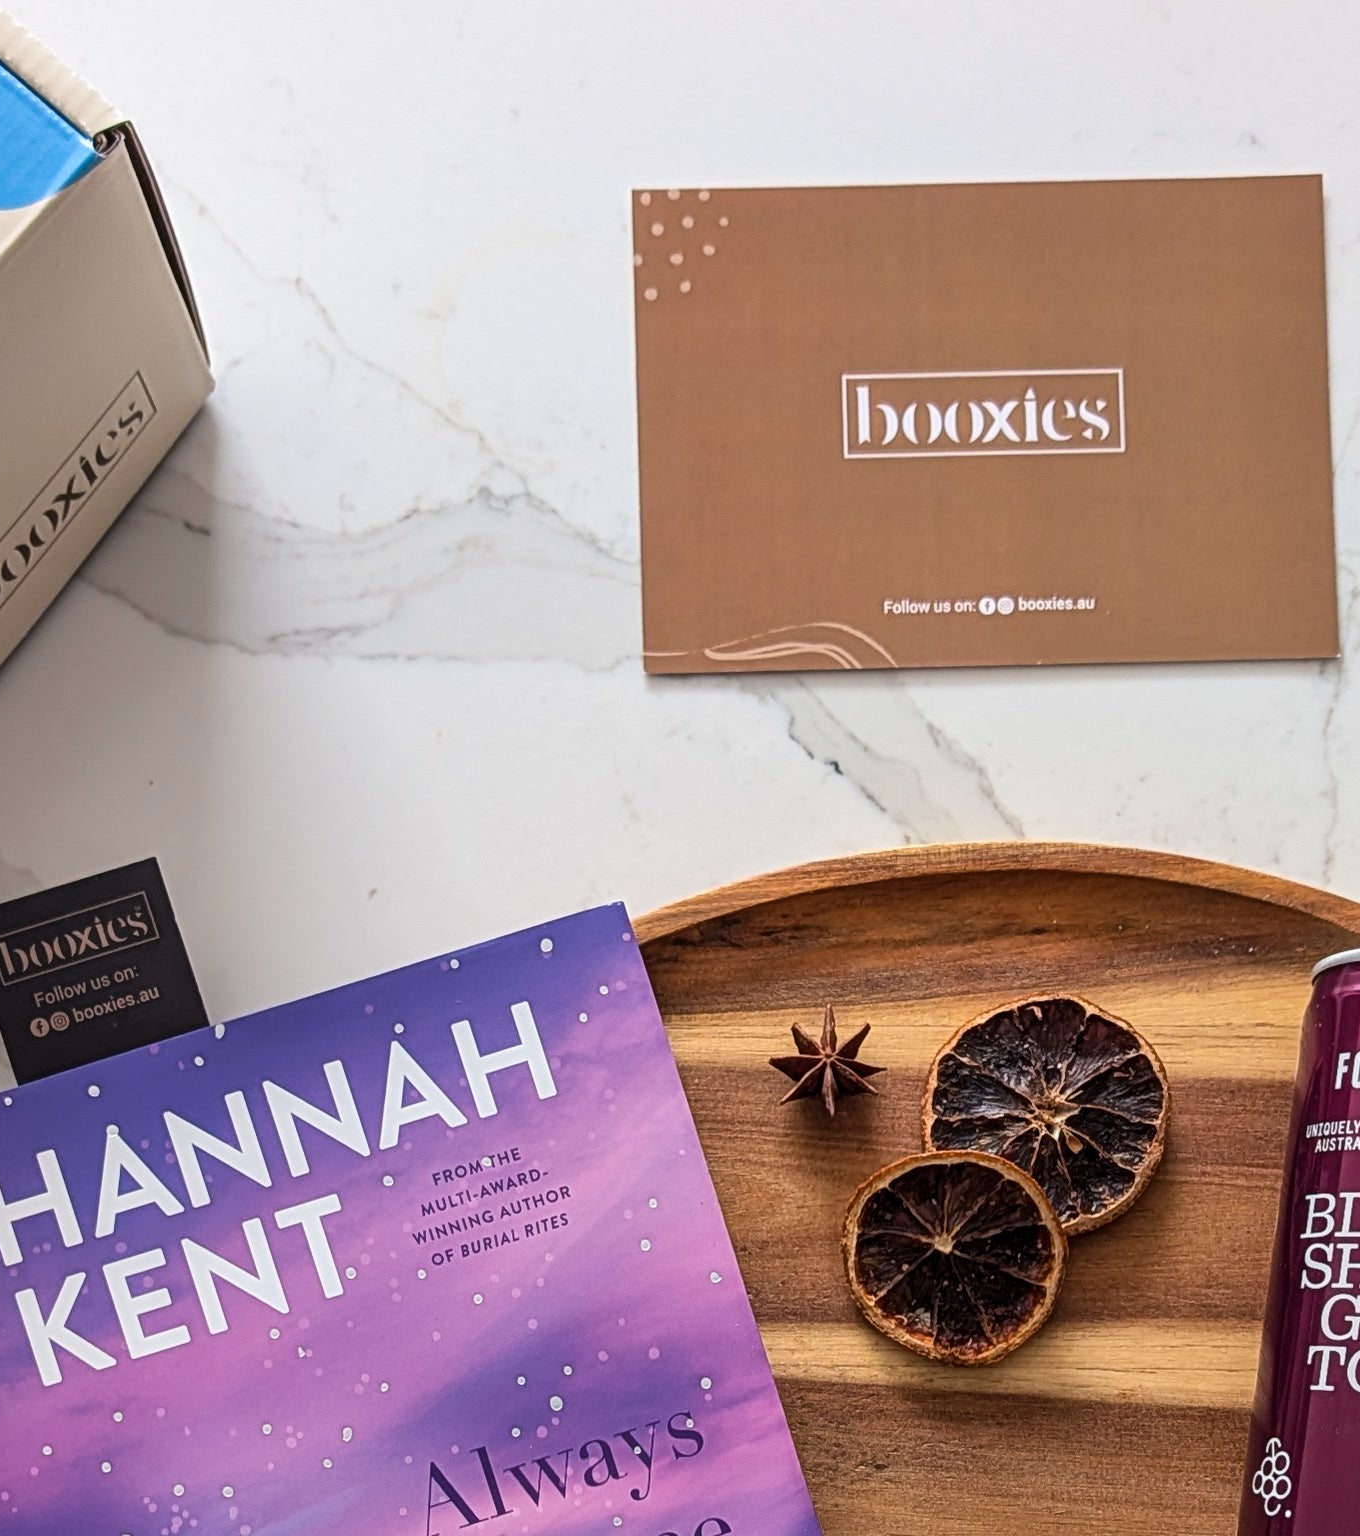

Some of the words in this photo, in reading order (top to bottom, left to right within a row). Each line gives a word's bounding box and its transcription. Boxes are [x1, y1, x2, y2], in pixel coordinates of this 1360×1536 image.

[855, 385, 1112, 447] booxies
[883, 600, 931, 615] Follow
[933, 601, 951, 613] us
[954, 600, 977, 613] on:
[1018, 596, 1096, 612] booxies.au
[0, 908, 149, 976] booxies
[33, 981, 87, 1008] Follow
[90, 974, 111, 991] us
[113, 966, 140, 984] on:
[72, 985, 160, 1023] booxies.au
[431, 1159, 484, 1186] FROM
[488, 1147, 522, 1169] THE
[412, 1210, 494, 1245] WINNING
[500, 1185, 571, 1220] AUTHOR
[421, 1168, 549, 1217] MULTI-AWARD-
[431, 1248, 454, 1266] OF
[460, 1229, 520, 1258] BURIAL
[524, 1213, 569, 1238] RITES
[15, 1194, 344, 1387] KENT
